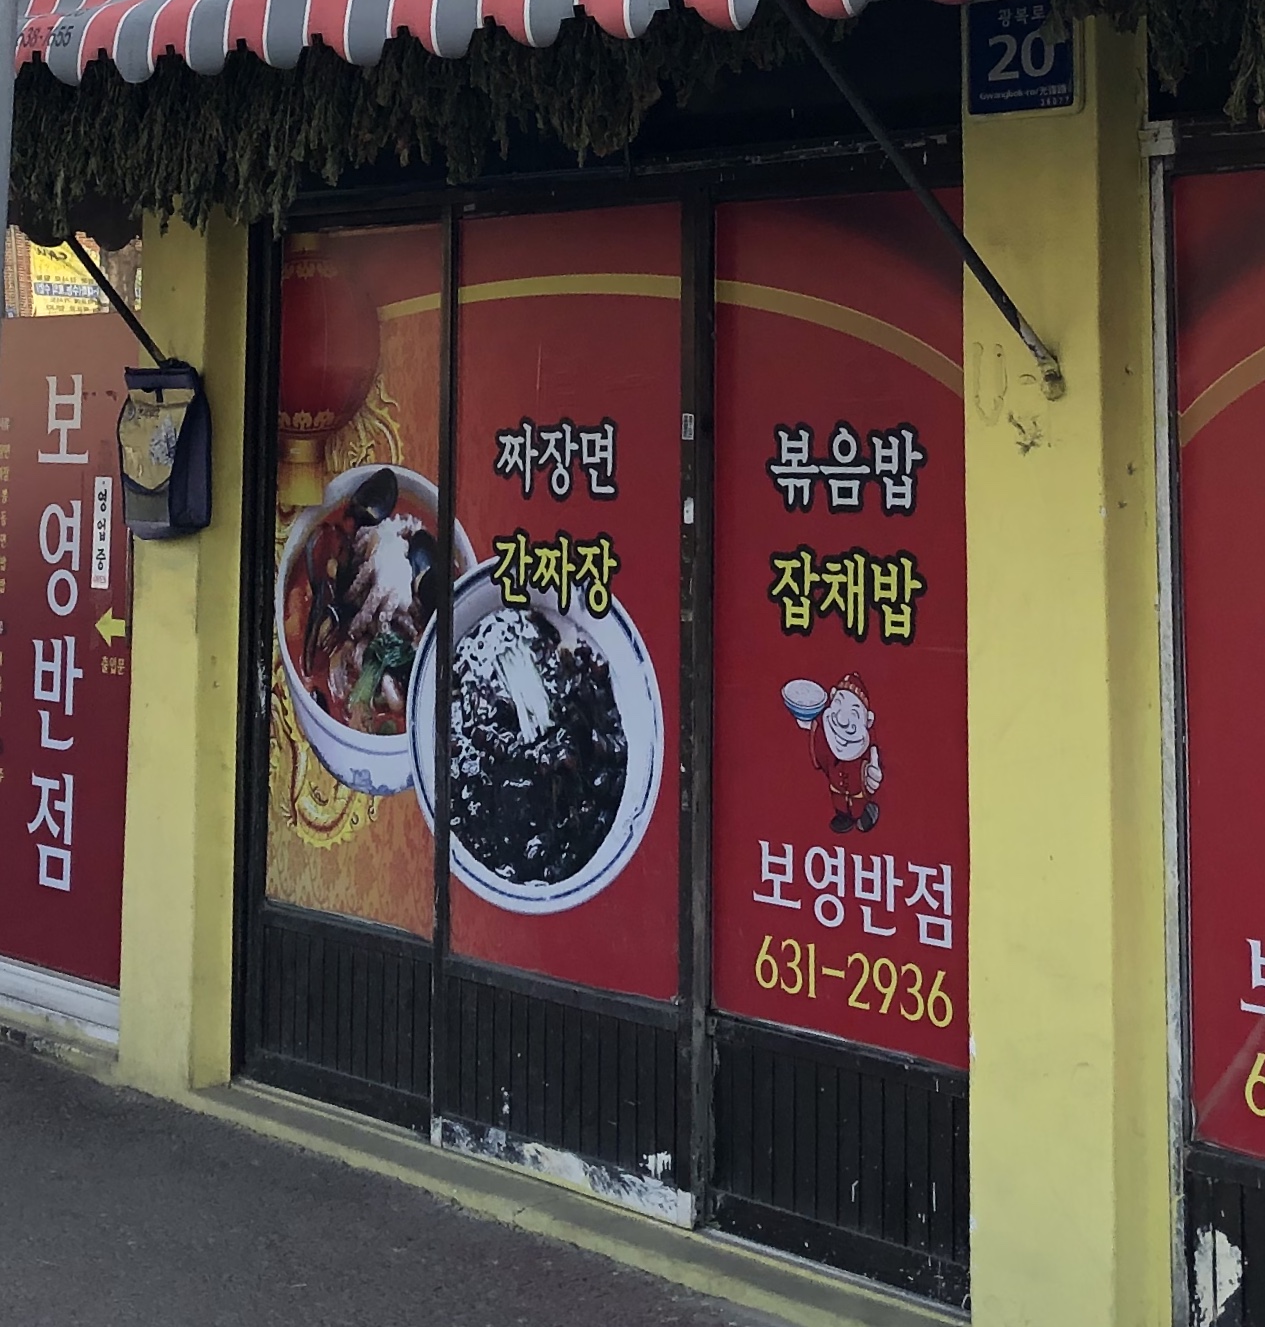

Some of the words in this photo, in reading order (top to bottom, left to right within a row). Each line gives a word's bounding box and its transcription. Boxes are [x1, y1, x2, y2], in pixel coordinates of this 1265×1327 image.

[987, 28, 1056, 82] 20
[997, 4, 1046, 28] 광복로
[495, 422, 616, 496] 짜장면
[769, 427, 923, 510] 볶음밥
[95, 488, 108, 572] 영업중
[493, 532, 618, 613] 간짜장
[770, 550, 922, 639] 잡채밥
[27, 373, 89, 893] 보영반점
[101, 655, 126, 676] 출입문
[752, 839, 954, 949] 보영반점
[753, 934, 954, 1028] 631-2936
